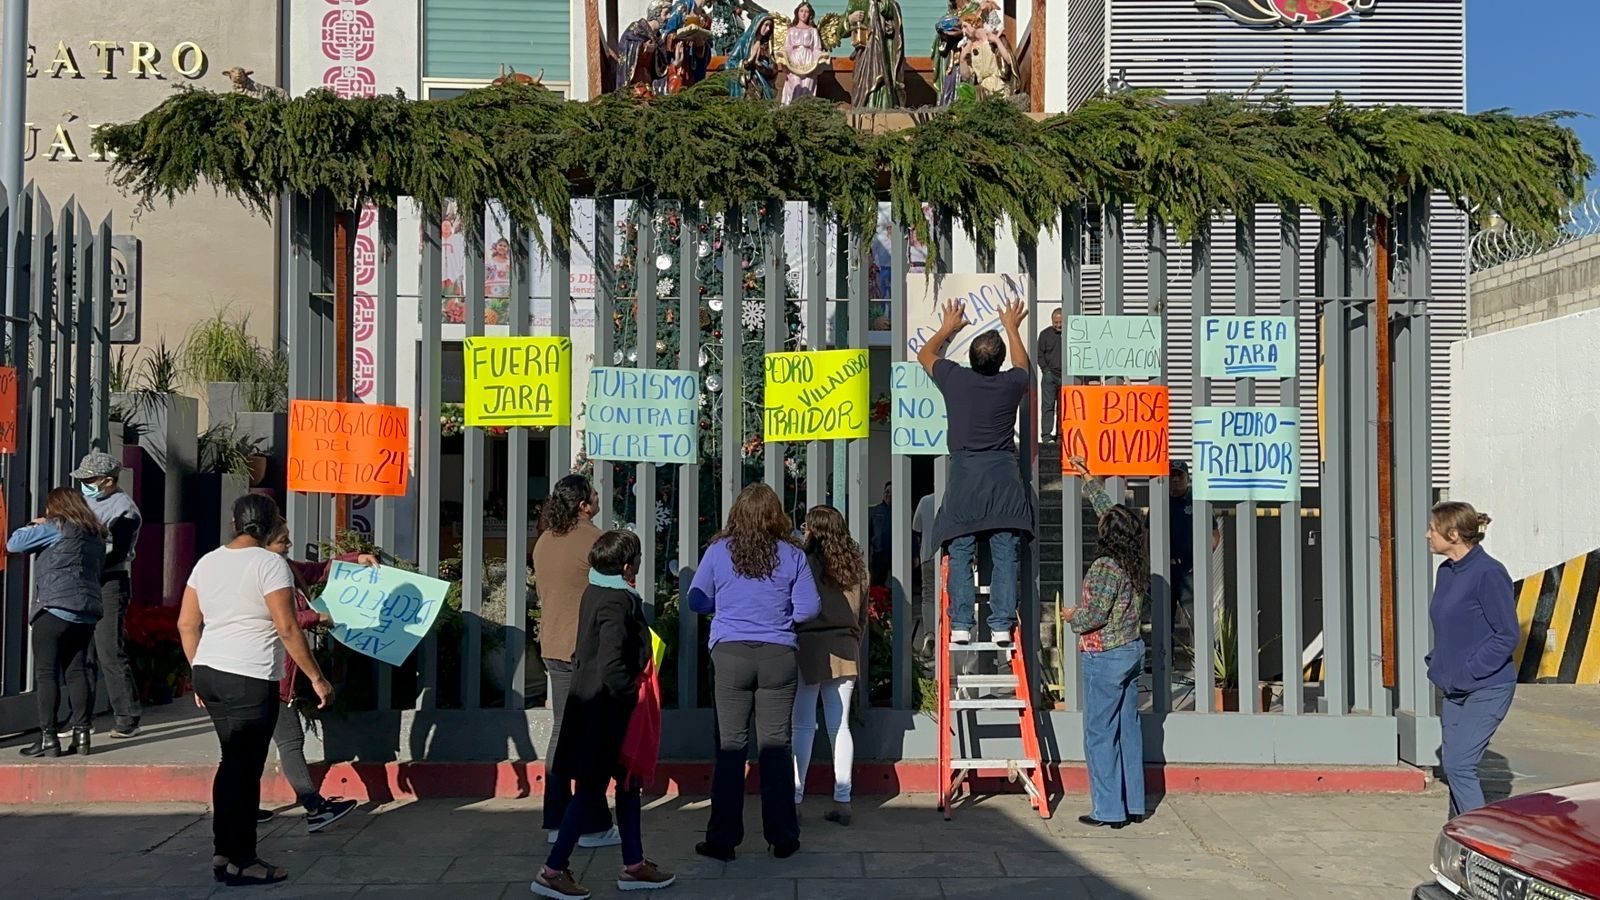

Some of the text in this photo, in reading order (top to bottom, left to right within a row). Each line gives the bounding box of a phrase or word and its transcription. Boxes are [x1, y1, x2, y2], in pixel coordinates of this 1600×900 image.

[1070, 318, 1156, 343] SI A LA
[1206, 318, 1287, 341] FUERA
[1224, 343, 1278, 366] JARA
[483, 383, 553, 414] JARA
[591, 369, 696, 401] TURISMO
[589, 404, 672, 427] CONTRA
[765, 400, 863, 437] TRAIDOR
[898, 397, 934, 419] NO
[1062, 389, 1164, 424] LA BASE
[291, 403, 408, 439] ABROGACIÓN
[1221, 411, 1277, 437] PEDRO
[588, 432, 691, 458] DECRETO
[1194, 440, 1293, 476] TRAIDOR
[289, 448, 405, 485] DECRETO 24
